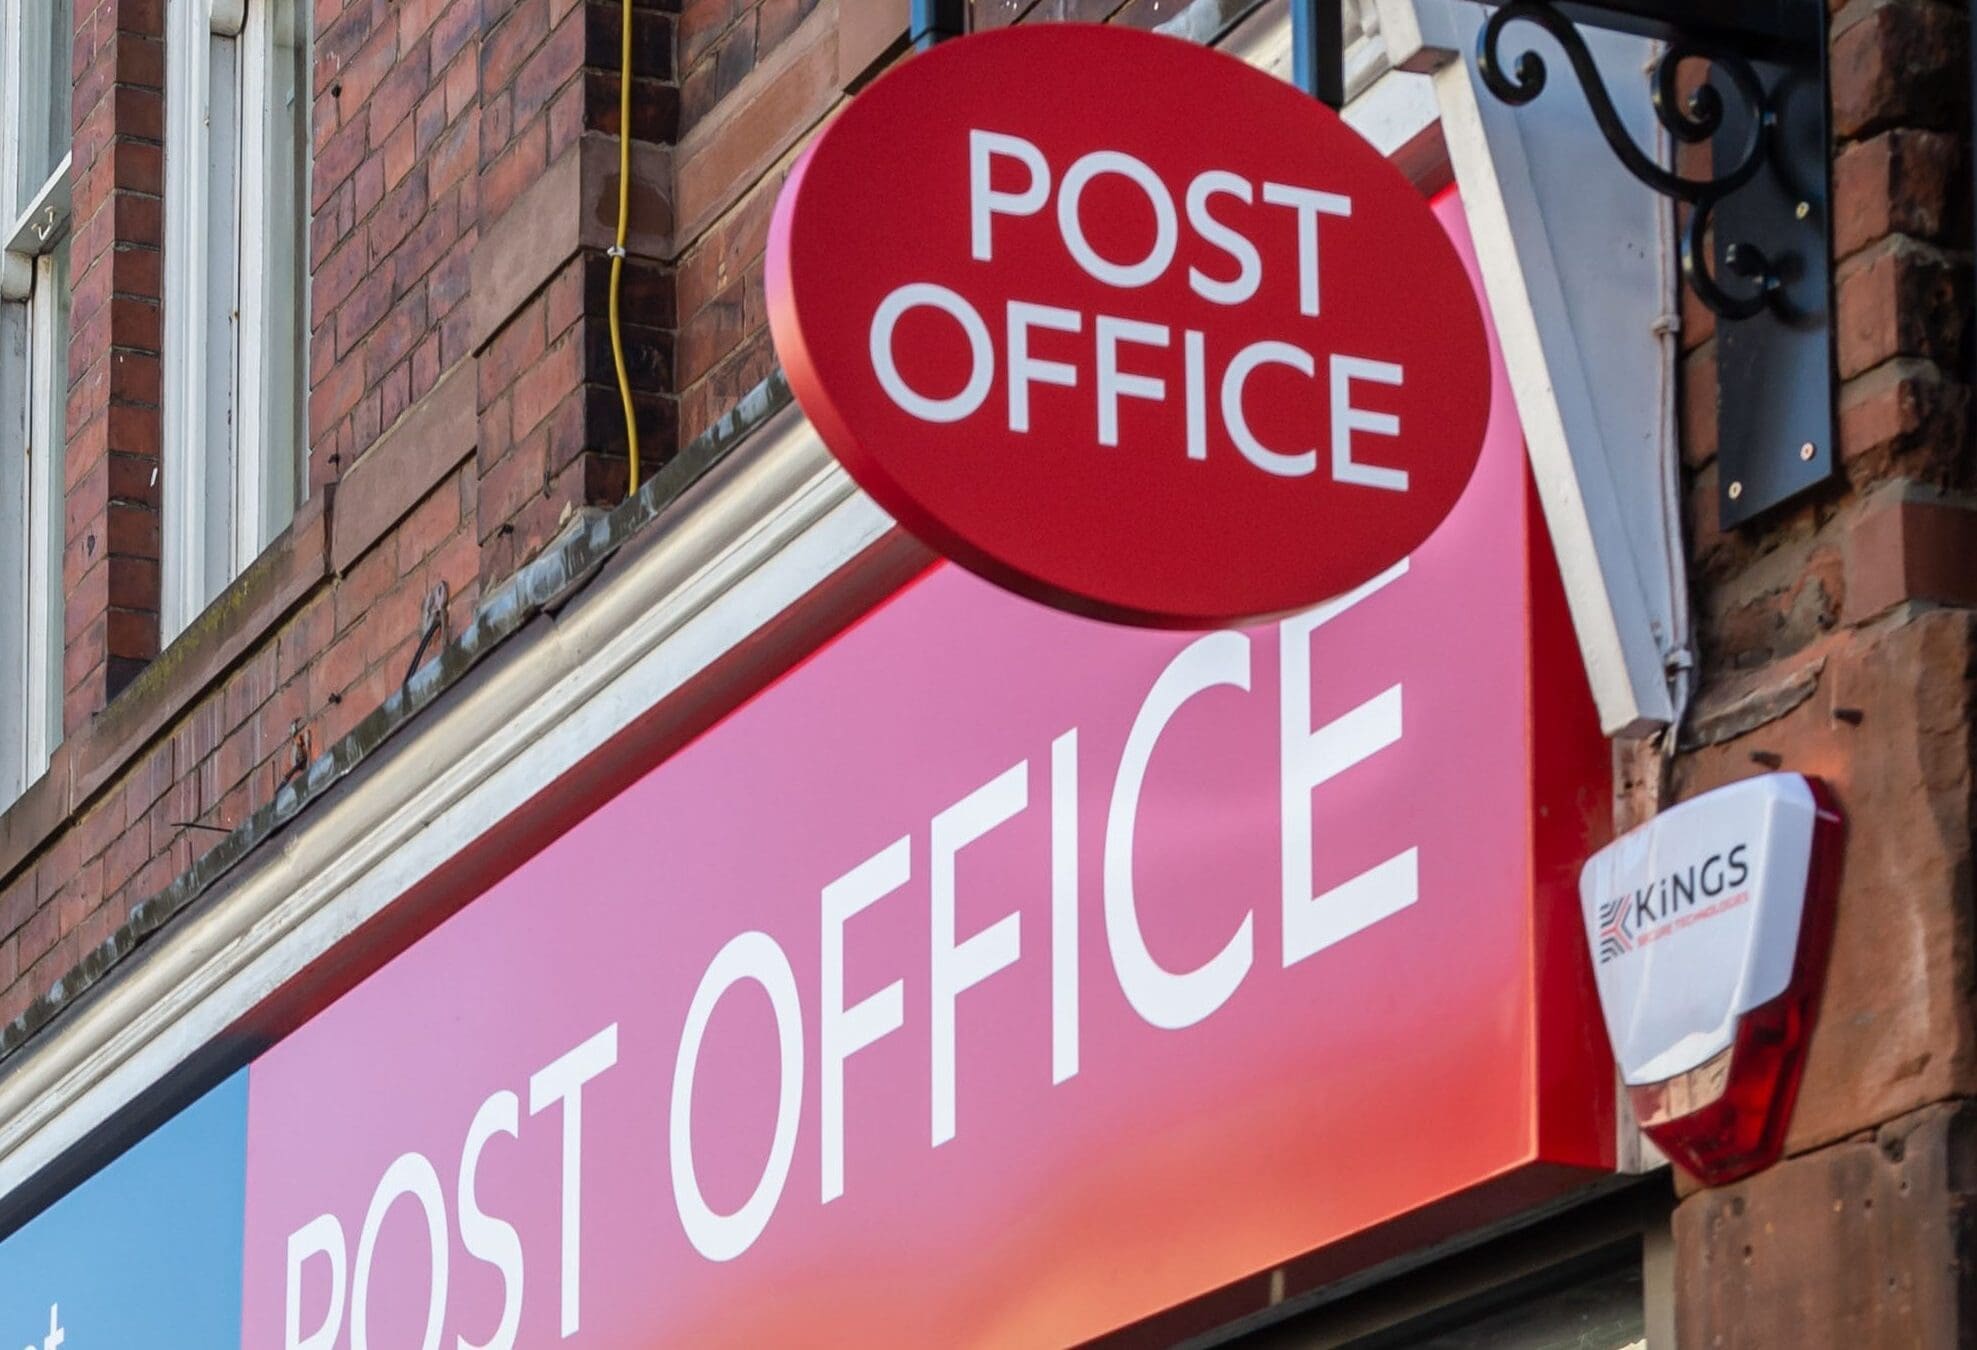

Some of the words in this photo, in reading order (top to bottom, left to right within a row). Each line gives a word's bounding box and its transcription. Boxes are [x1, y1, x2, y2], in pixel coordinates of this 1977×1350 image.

[969, 129, 1352, 317] POST
[869, 282, 1409, 492] OFFICE
[285, 1022, 618, 1350] POST
[670, 556, 1419, 1262] OFFICE
